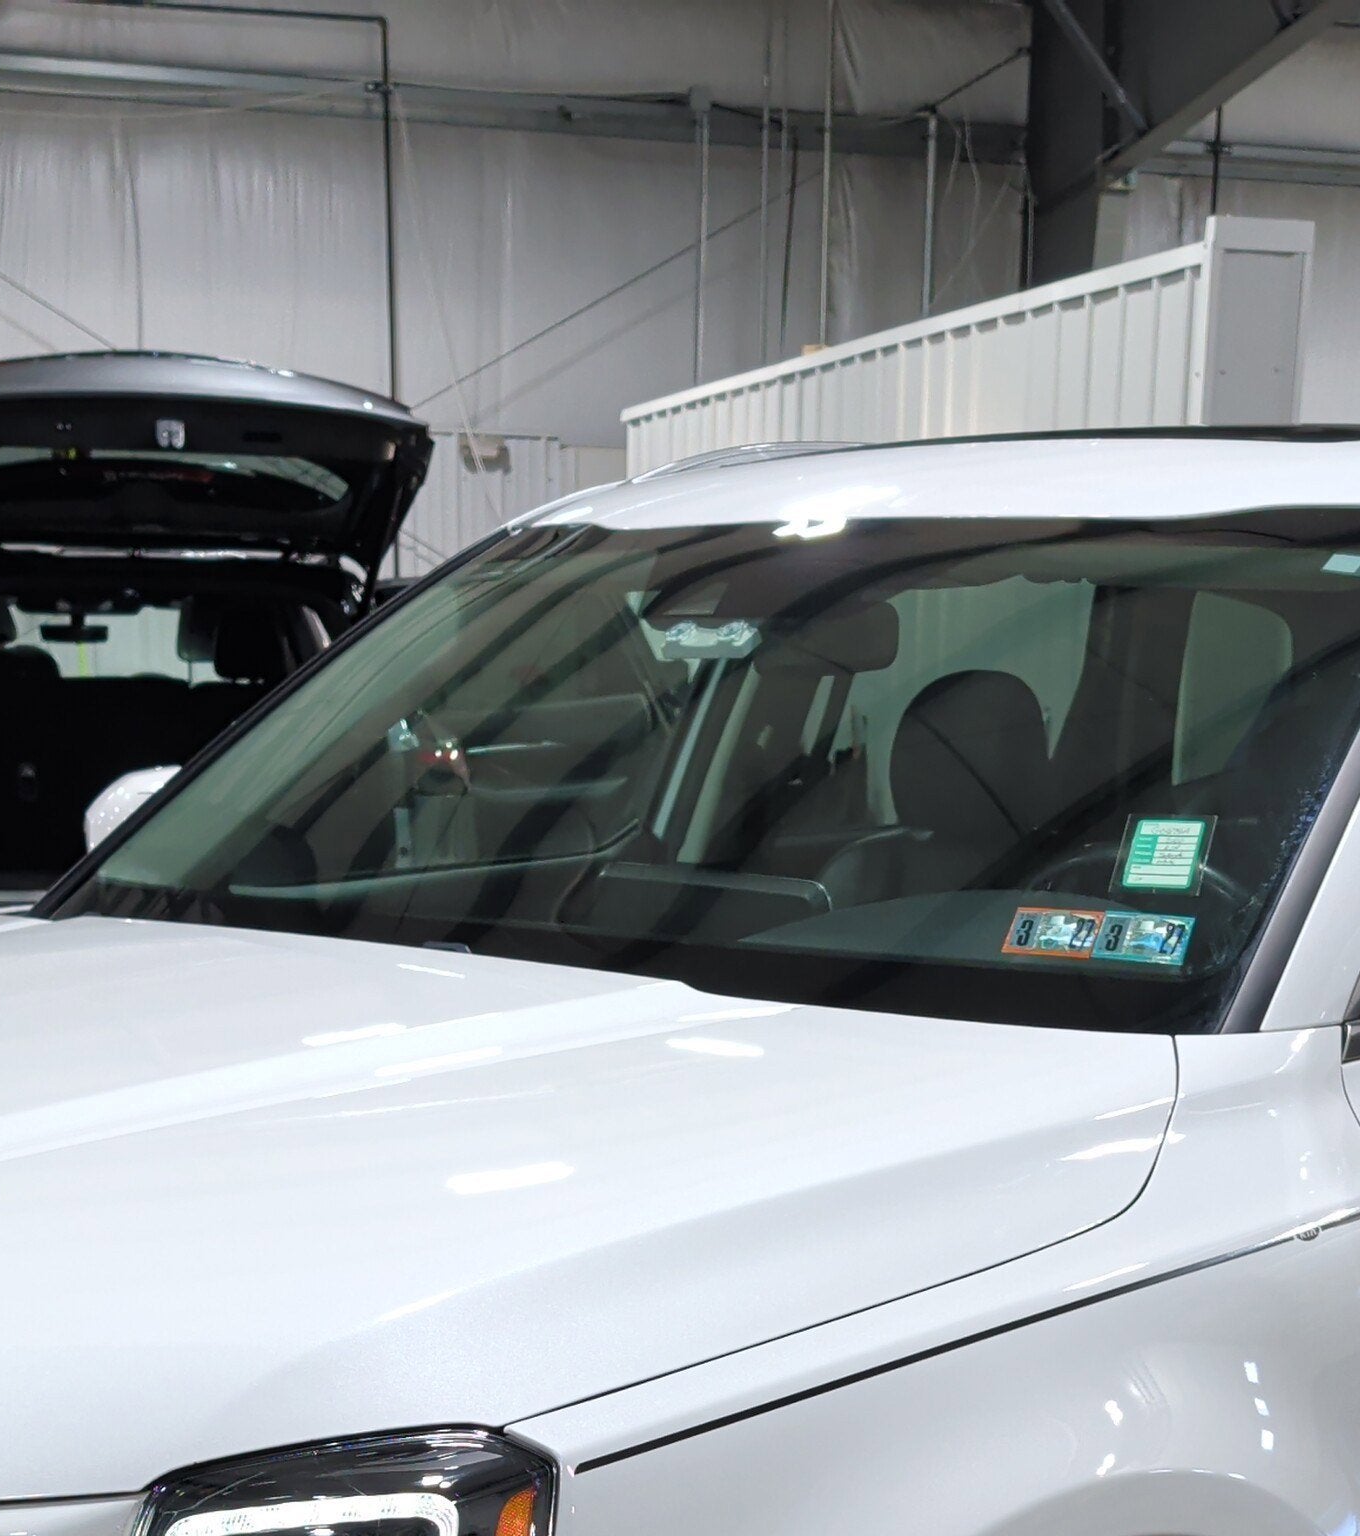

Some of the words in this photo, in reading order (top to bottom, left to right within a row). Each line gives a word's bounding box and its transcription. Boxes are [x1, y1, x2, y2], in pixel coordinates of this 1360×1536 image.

[1016, 919, 1034, 947] 3
[1069, 917, 1095, 949] 27
[1105, 923, 1123, 951] 3
